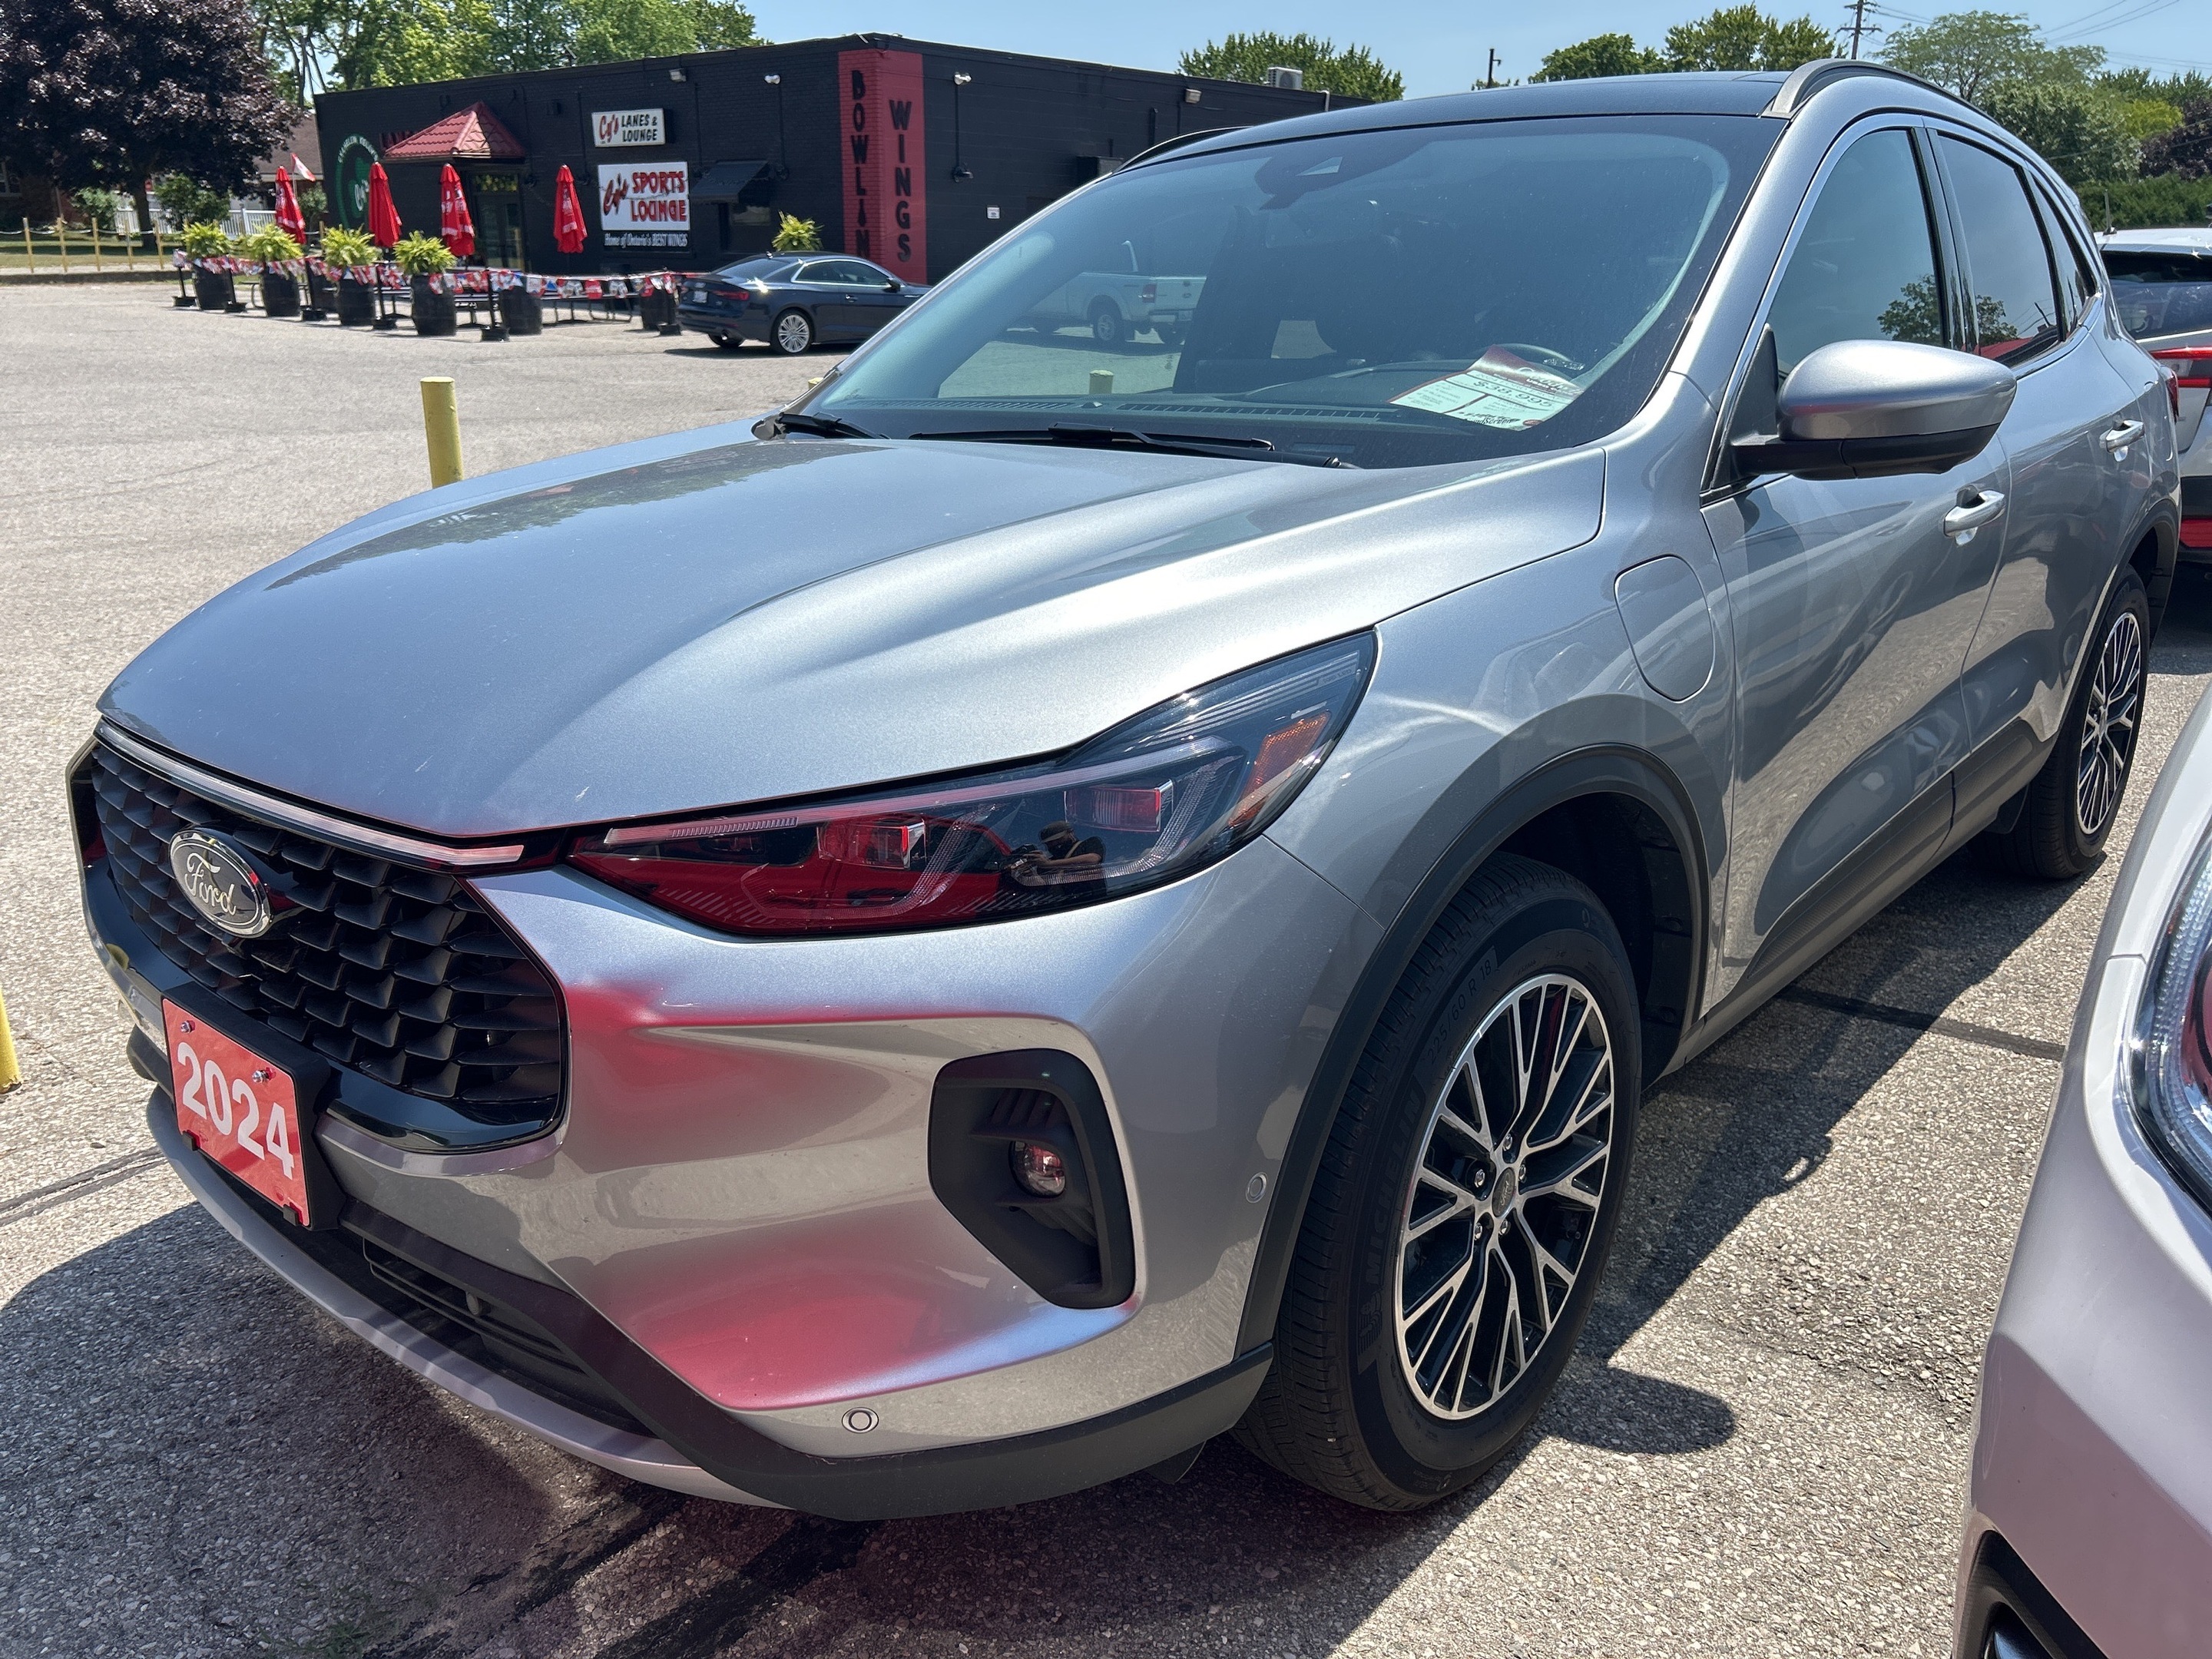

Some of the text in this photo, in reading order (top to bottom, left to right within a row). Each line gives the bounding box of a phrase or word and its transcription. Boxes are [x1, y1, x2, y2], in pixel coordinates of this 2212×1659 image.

[621, 114, 658, 128] LANES &
[622, 128, 658, 142] LOUNGE
[632, 171, 685, 194] SPORTS
[889, 99, 912, 263] WINGS
[631, 200, 687, 222] LOUNGE
[651, 233, 667, 247] BEST
[667, 233, 688, 247] WINGS
[184, 853, 237, 916] Ford
[1427, 959, 1492, 1065] 225/60 R 18
[177, 1041, 295, 1181] 2024
[1365, 1087, 1422, 1285] MICHELIN
